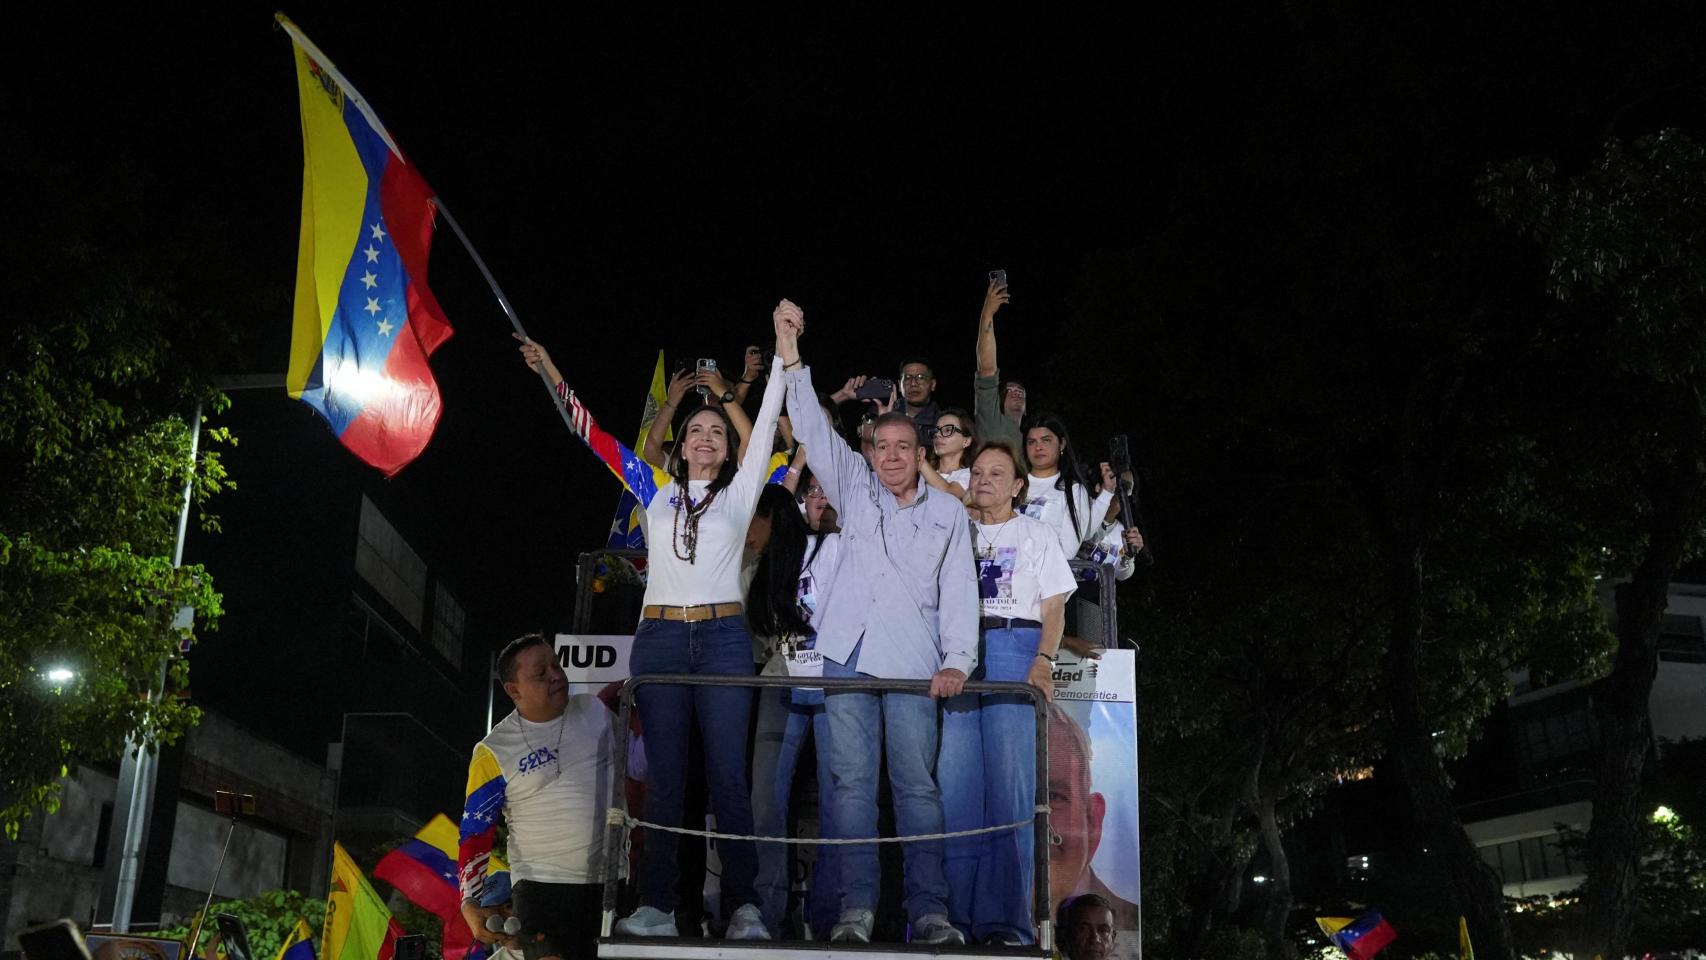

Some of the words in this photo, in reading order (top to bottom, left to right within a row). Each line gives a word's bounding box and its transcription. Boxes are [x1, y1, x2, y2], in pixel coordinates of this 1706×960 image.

[557, 645, 617, 668] MUD
[1052, 669, 1083, 682] dad
[1053, 689, 1118, 700] Democrática
